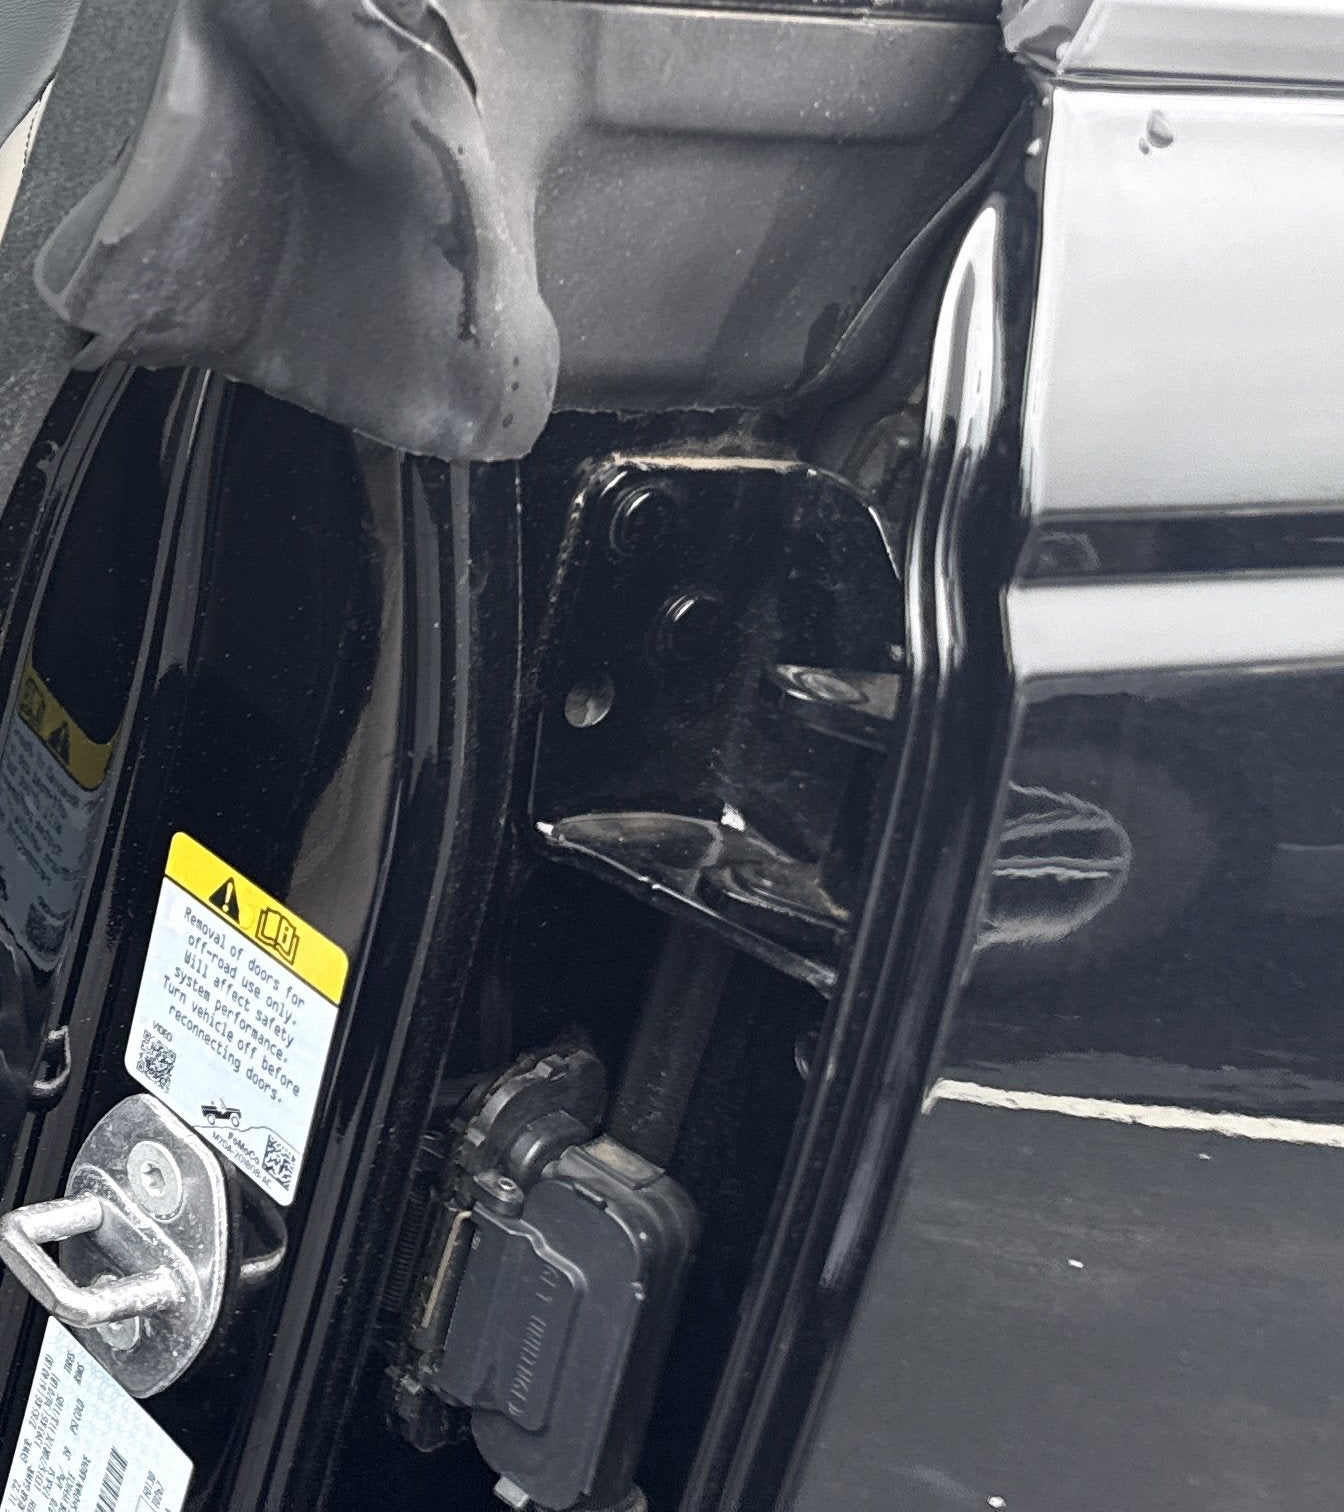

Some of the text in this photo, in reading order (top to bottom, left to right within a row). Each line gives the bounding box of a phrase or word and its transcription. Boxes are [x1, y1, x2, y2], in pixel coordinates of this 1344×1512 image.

[184, 907, 305, 1008] Removal of doors for
[184, 949, 294, 1049] Will affect safety
[188, 935, 296, 1025] off-road use only.
[164, 975, 300, 1097] Turn vehicle off before
[169, 1005, 282, 1103] reconnecting doors.
[174, 967, 288, 1063] system performance.
